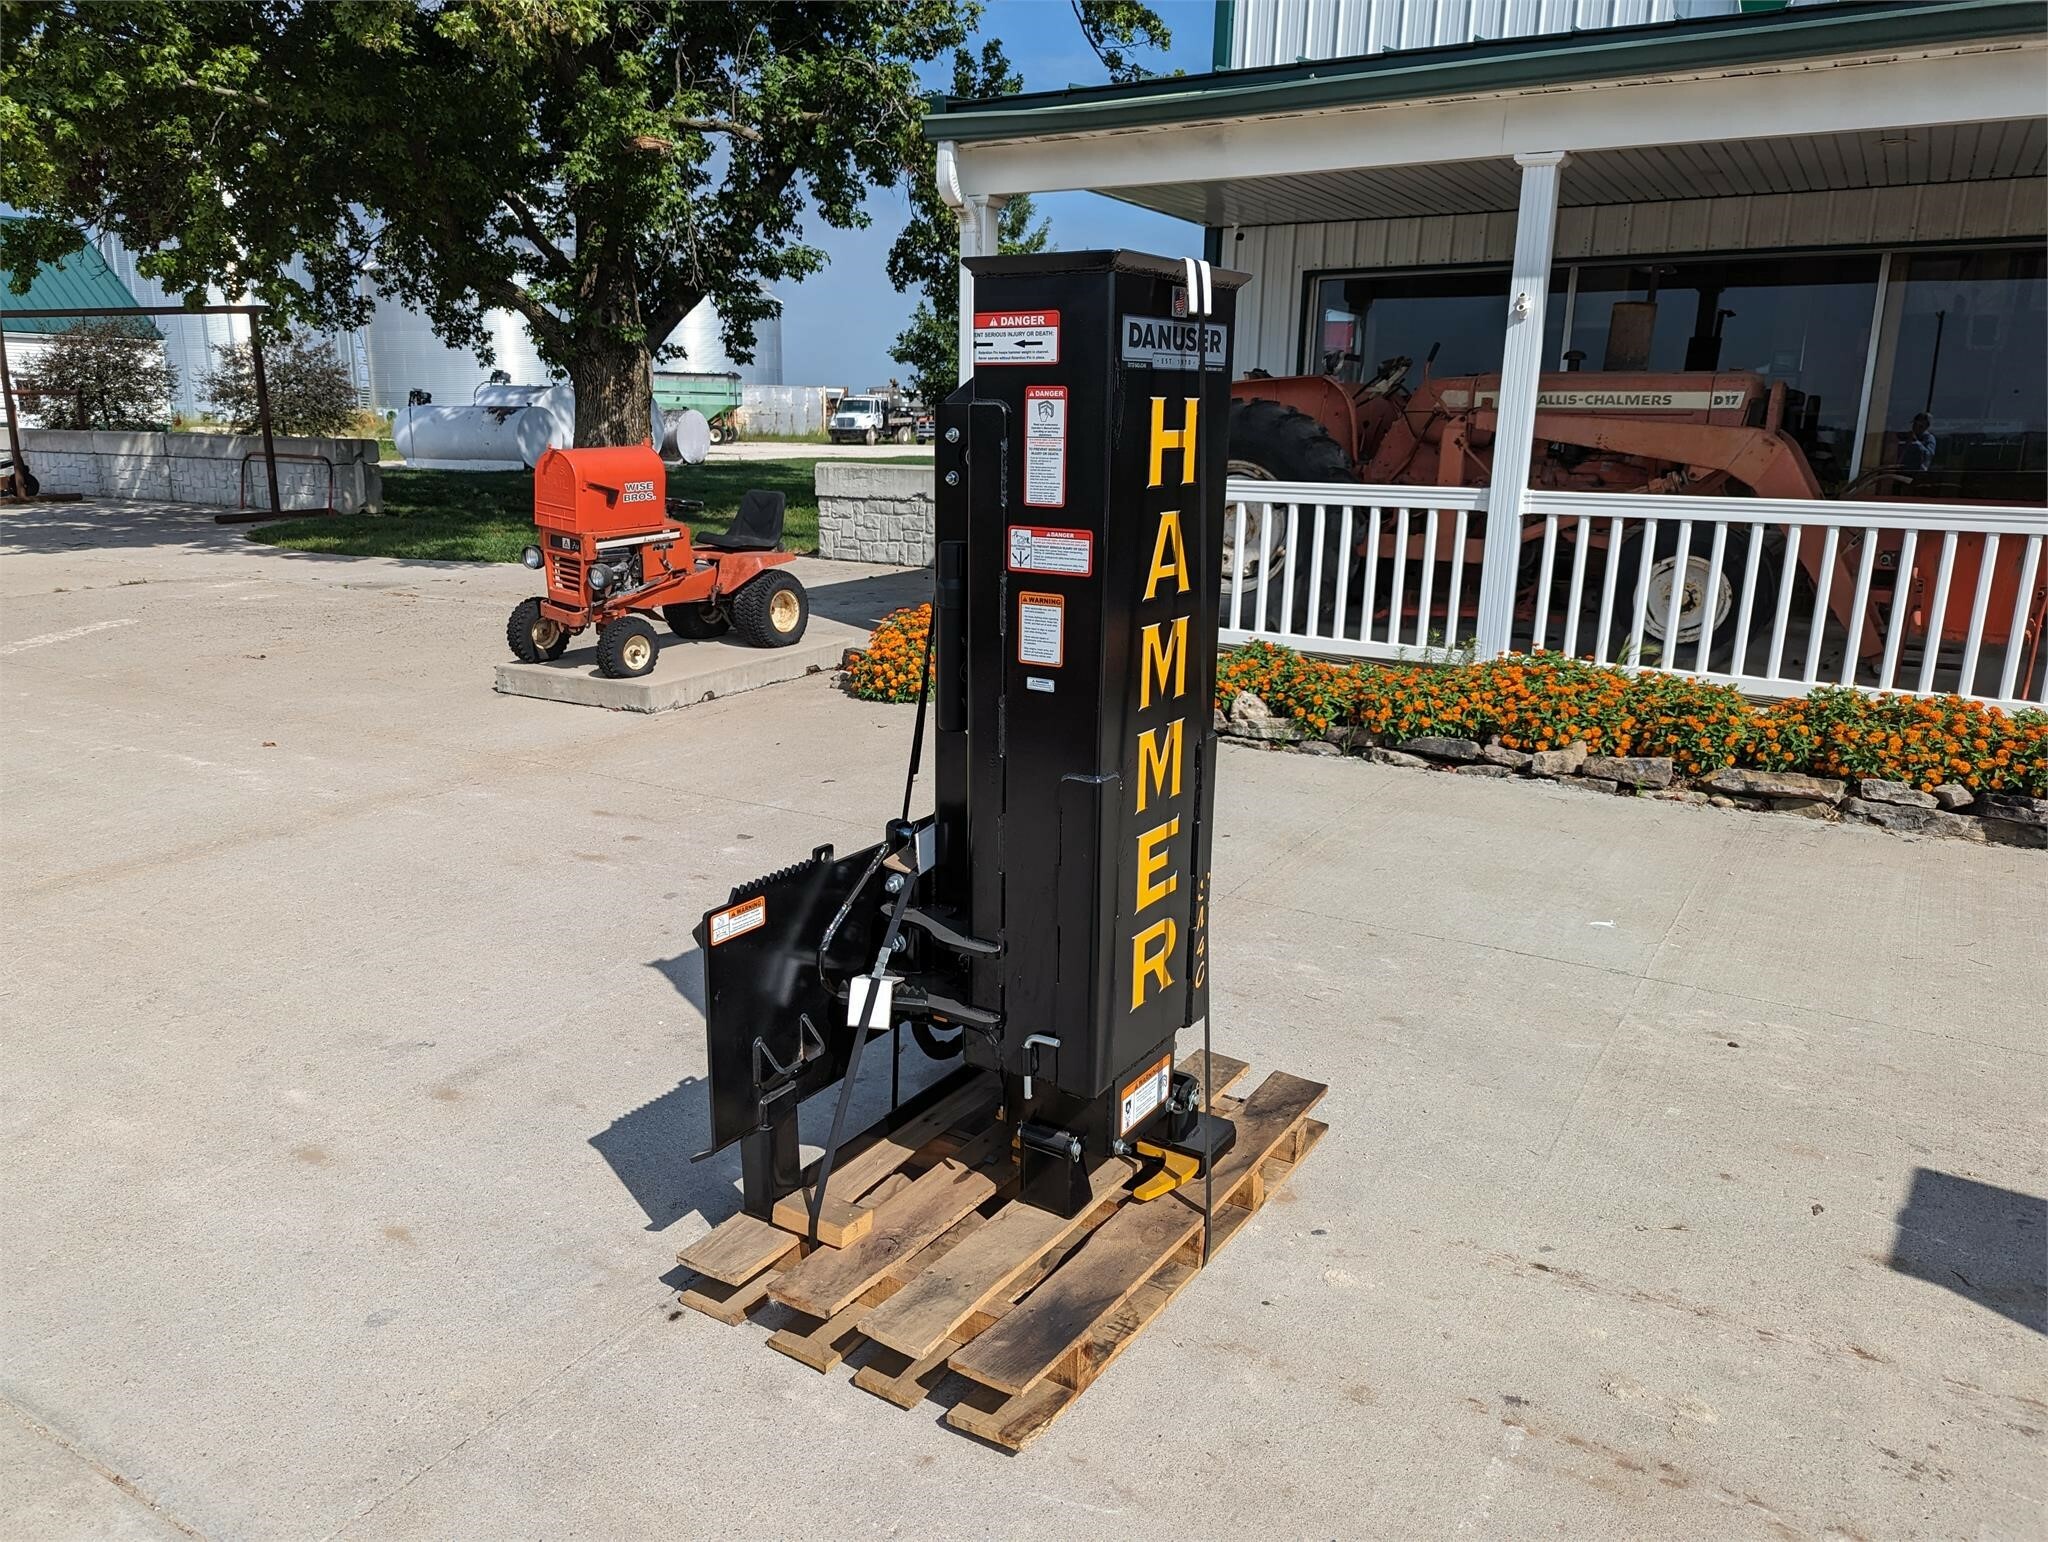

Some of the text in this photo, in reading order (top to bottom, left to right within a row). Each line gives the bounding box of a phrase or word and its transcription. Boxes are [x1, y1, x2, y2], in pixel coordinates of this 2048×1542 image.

[1000, 315, 1046, 326] DANGER
[1538, 394, 1739, 406] ALLIS-CHALMERS D17
[625, 482, 653, 491] WISE
[623, 492, 656, 503] BROS.
[1029, 596, 1060, 605] WARNING
[1129, 396, 1201, 1014] HAMMER
